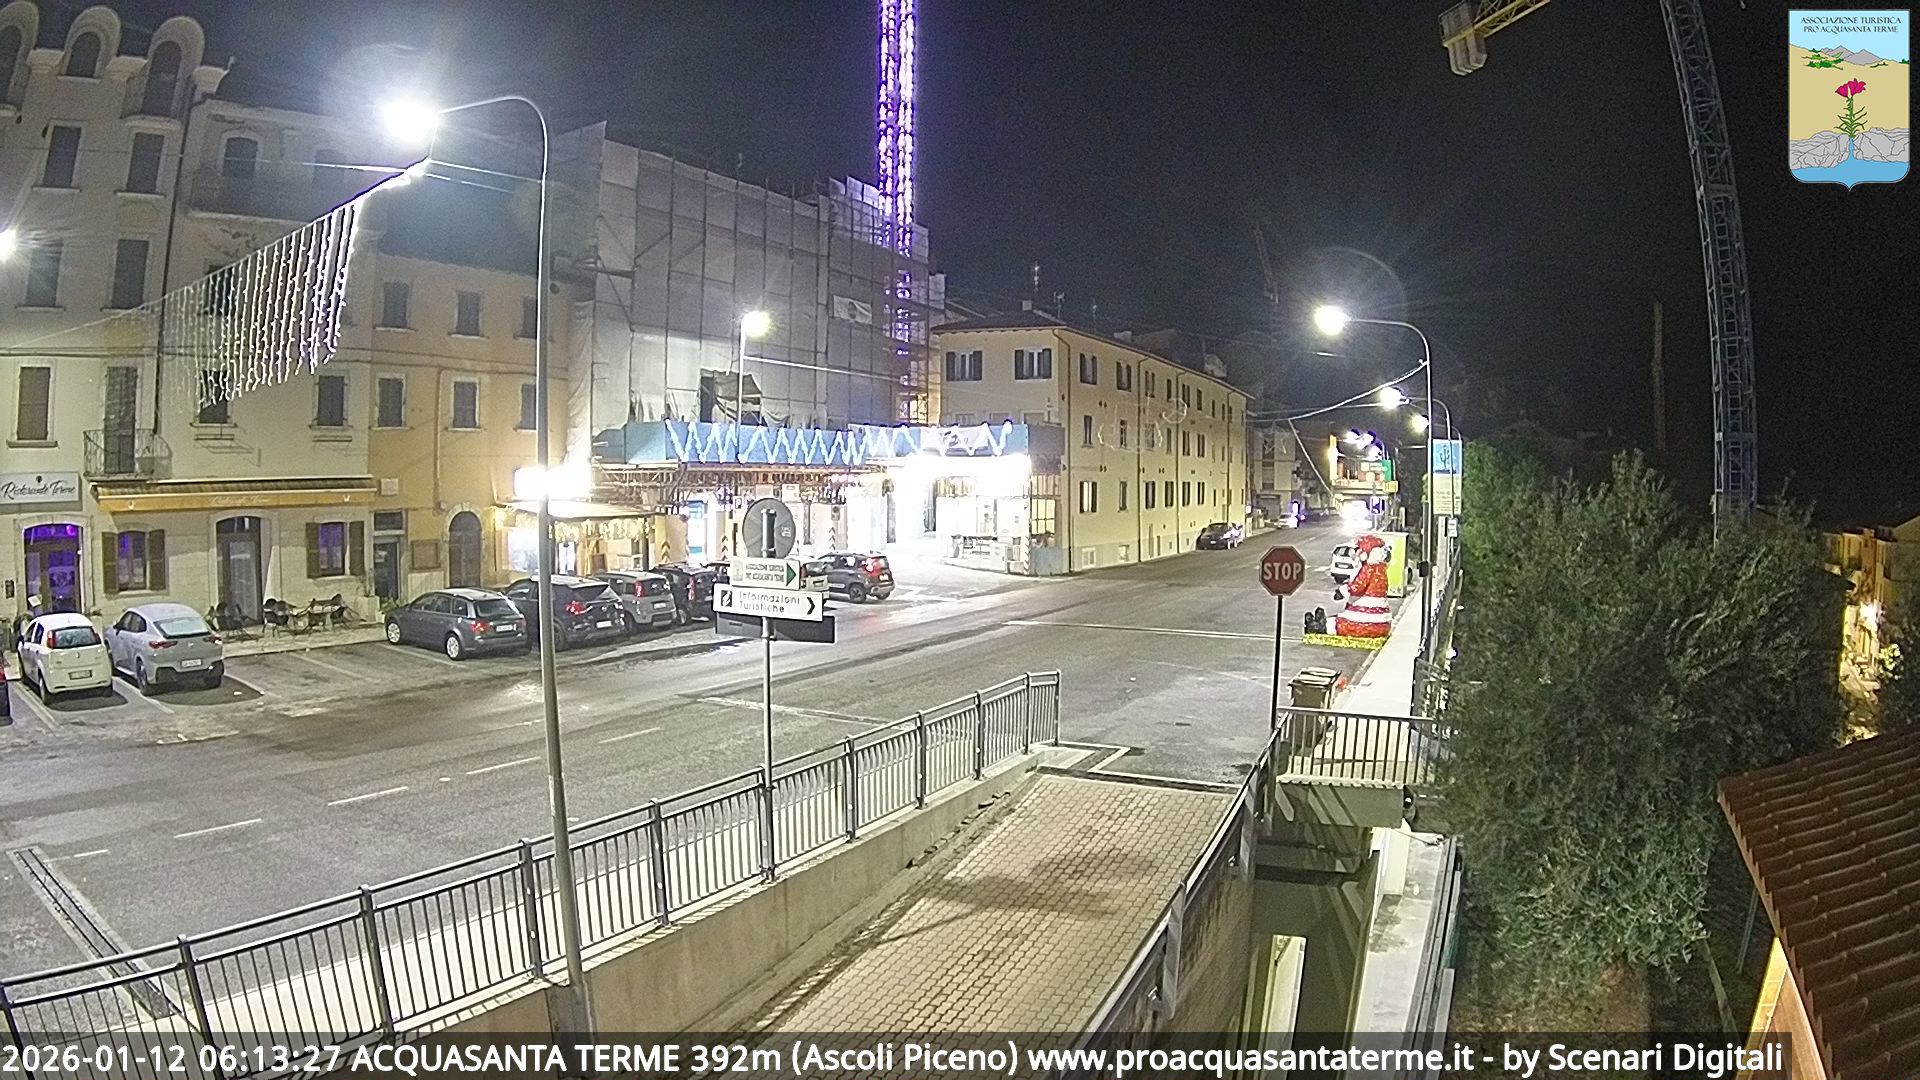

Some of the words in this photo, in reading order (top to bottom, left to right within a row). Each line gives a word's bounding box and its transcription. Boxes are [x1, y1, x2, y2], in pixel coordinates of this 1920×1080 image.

[1263, 562, 1301, 580] STOP
[739, 591, 801, 605] Informazioni
[739, 600, 785, 613] Turistiche
